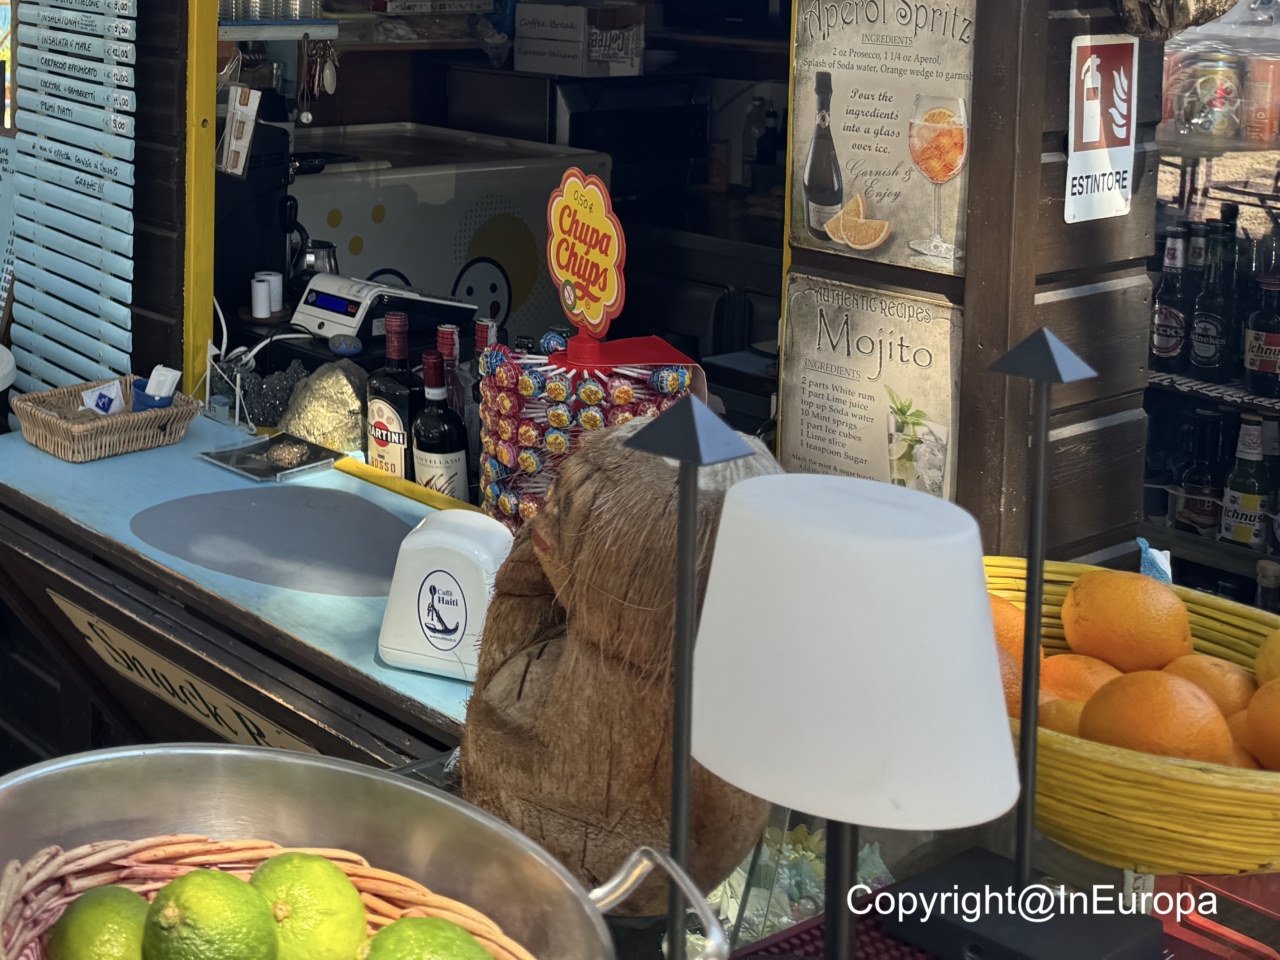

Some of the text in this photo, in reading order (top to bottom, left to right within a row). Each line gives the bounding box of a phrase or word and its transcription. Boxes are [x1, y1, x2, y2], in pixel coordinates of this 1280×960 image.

[74, 40, 92, 52] MARE
[861, 34, 914, 46] INGREDIENTS
[832, 47, 838, 56] 2
[849, 48, 882, 60] Prosecco,
[890, 52, 901, 62] 1/4
[902, 54, 912, 62] oz
[914, 54, 942, 66] Aperol,
[804, 58, 826, 69] Splash
[828, 60, 836, 68] of
[836, 60, 855, 71] Soda
[856, 63, 878, 74] water,
[880, 64, 908, 76] Orange
[910, 66, 934, 80] wedge
[936, 70, 943, 79] to
[850, 88, 894, 102] Pour the
[846, 106, 899, 120] ingredients
[842, 122, 861, 132] into
[874, 126, 900, 138] glass
[852, 142, 891, 154] over ice.
[846, 158, 914, 183] Garnish &
[864, 178, 902, 204] Enjoy
[1070, 170, 1128, 196] ESTINTORE
[558, 204, 612, 257] Chupa
[555, 238, 610, 302] Chups
[814, 287, 932, 324] AUTHENTIC RECIPES
[816, 308, 933, 382] Mojito
[804, 358, 861, 380] INGREDIENTS
[801, 376, 876, 402] 2 parts White rum
[800, 398, 875, 424] top up Soda water
[808, 390, 824, 400] part
[826, 394, 848, 406] Lime
[848, 401, 869, 412] juice
[800, 408, 858, 431] 10 Mint sprigs
[806, 420, 823, 432] part
[824, 425, 837, 435] Ice
[838, 430, 862, 442] cubes
[806, 430, 826, 443] Lime
[828, 438, 847, 448] slice
[800, 439, 868, 466] 1 teaspoon Sugar
[437, 588, 453, 598] Caffè
[437, 596, 458, 607] Haiti
[84, 620, 238, 737] Snack
